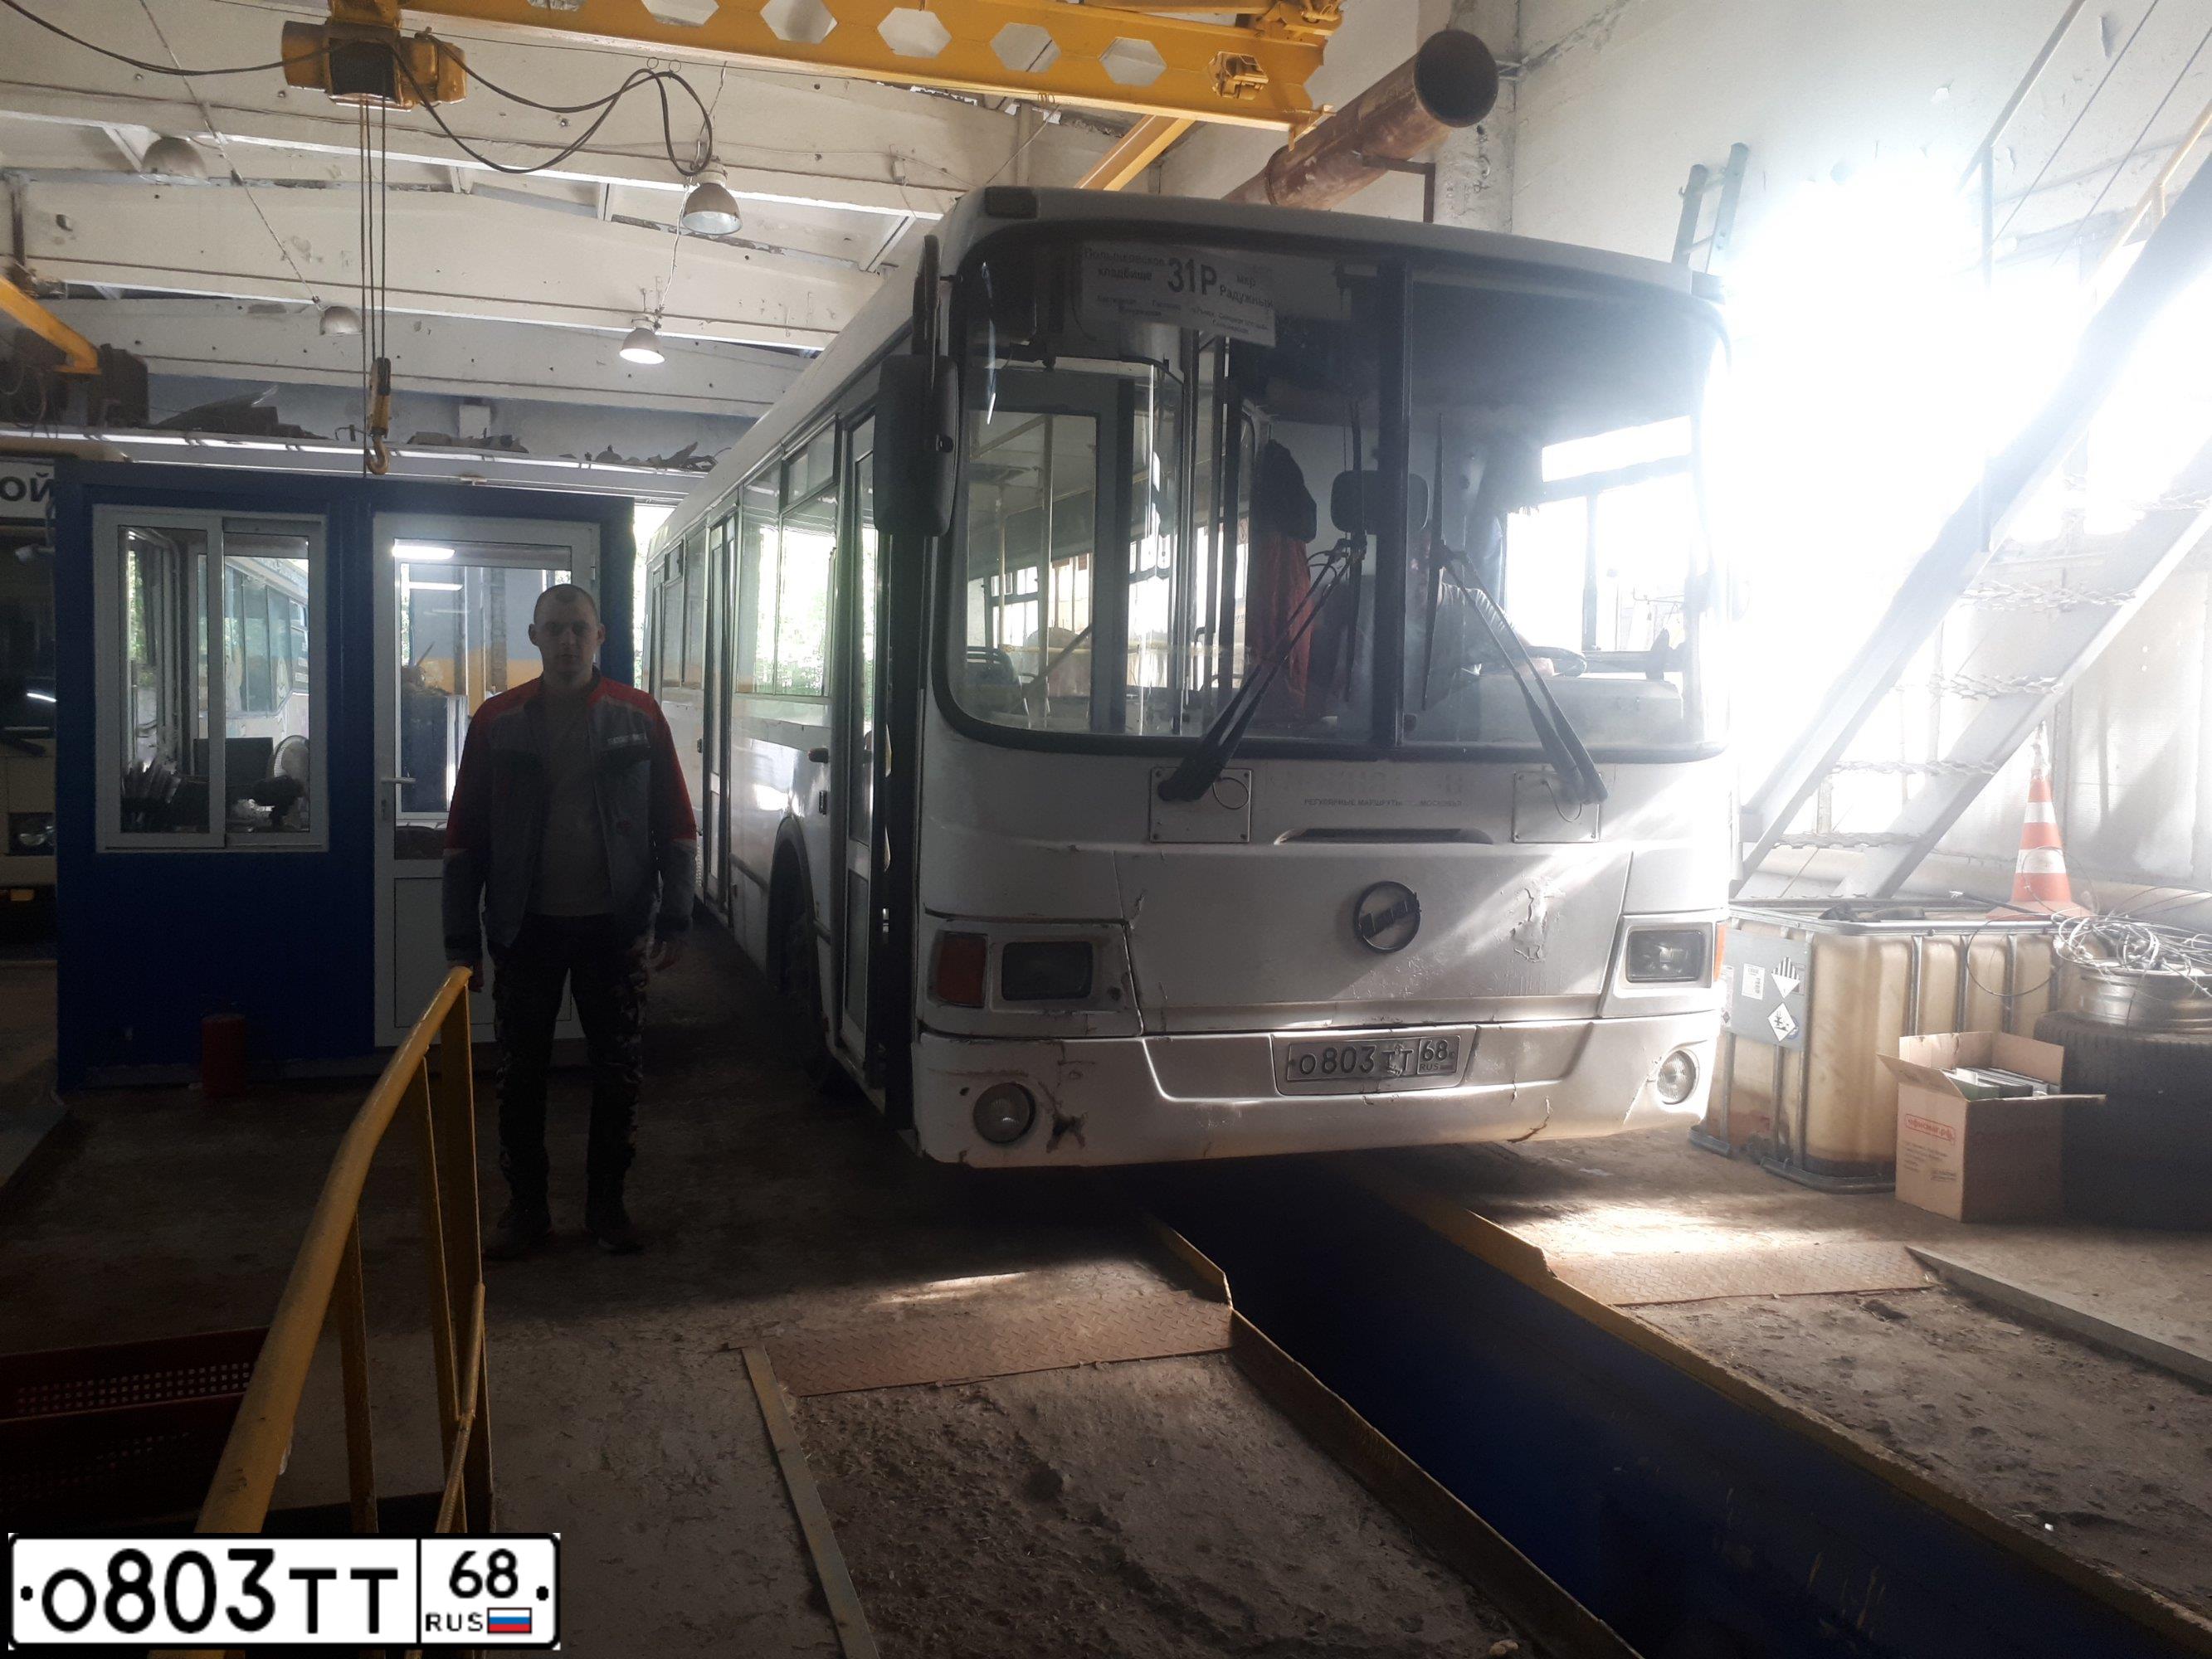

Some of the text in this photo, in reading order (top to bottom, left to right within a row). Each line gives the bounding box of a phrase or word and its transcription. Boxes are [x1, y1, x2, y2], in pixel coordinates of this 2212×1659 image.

[1167, 257, 1217, 295] 31Р
[1421, 1039, 1449, 1062] 68
[1420, 1063, 1440, 1071] RUS
